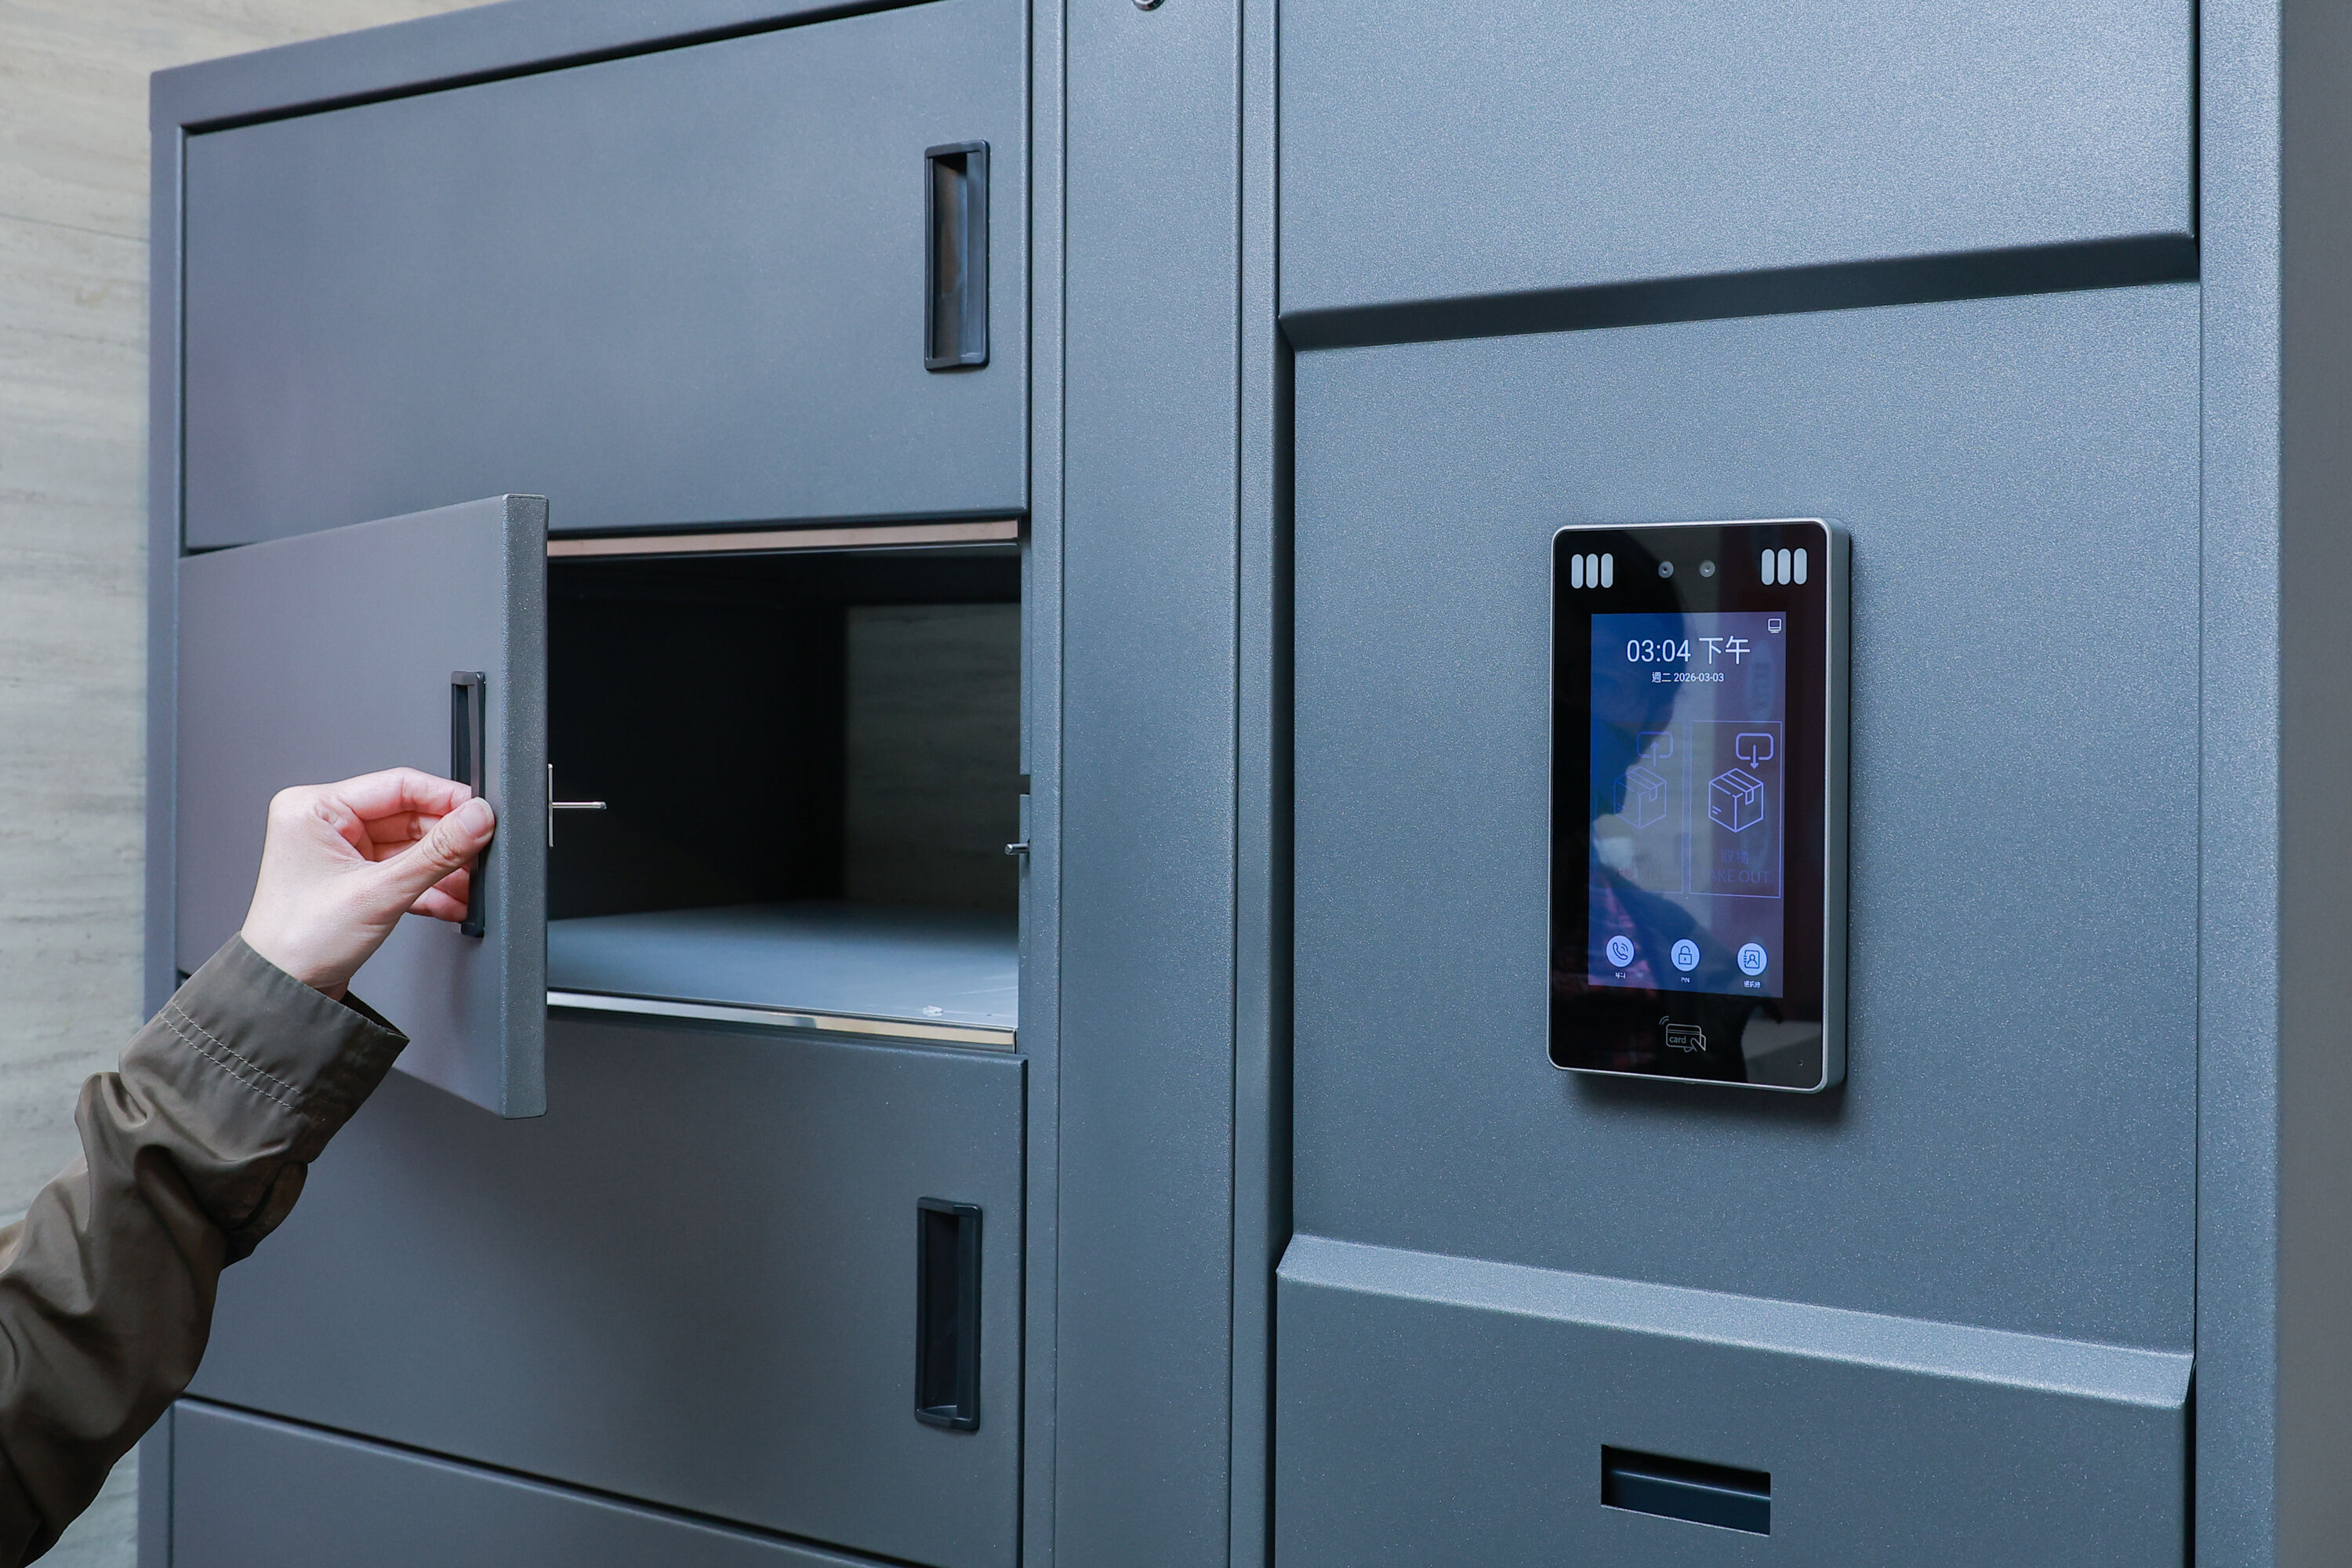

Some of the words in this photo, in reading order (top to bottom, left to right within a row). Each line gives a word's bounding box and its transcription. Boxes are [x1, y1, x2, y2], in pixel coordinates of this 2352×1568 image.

[1627, 639, 1691, 662] 03:04
[1698, 636, 1751, 665] 下午
[1651, 672, 1671, 683] 週二
[1674, 673, 1724, 682] 2026-03-03
[1738, 870, 1769, 884] OUT
[1669, 1036, 1686, 1044] card
